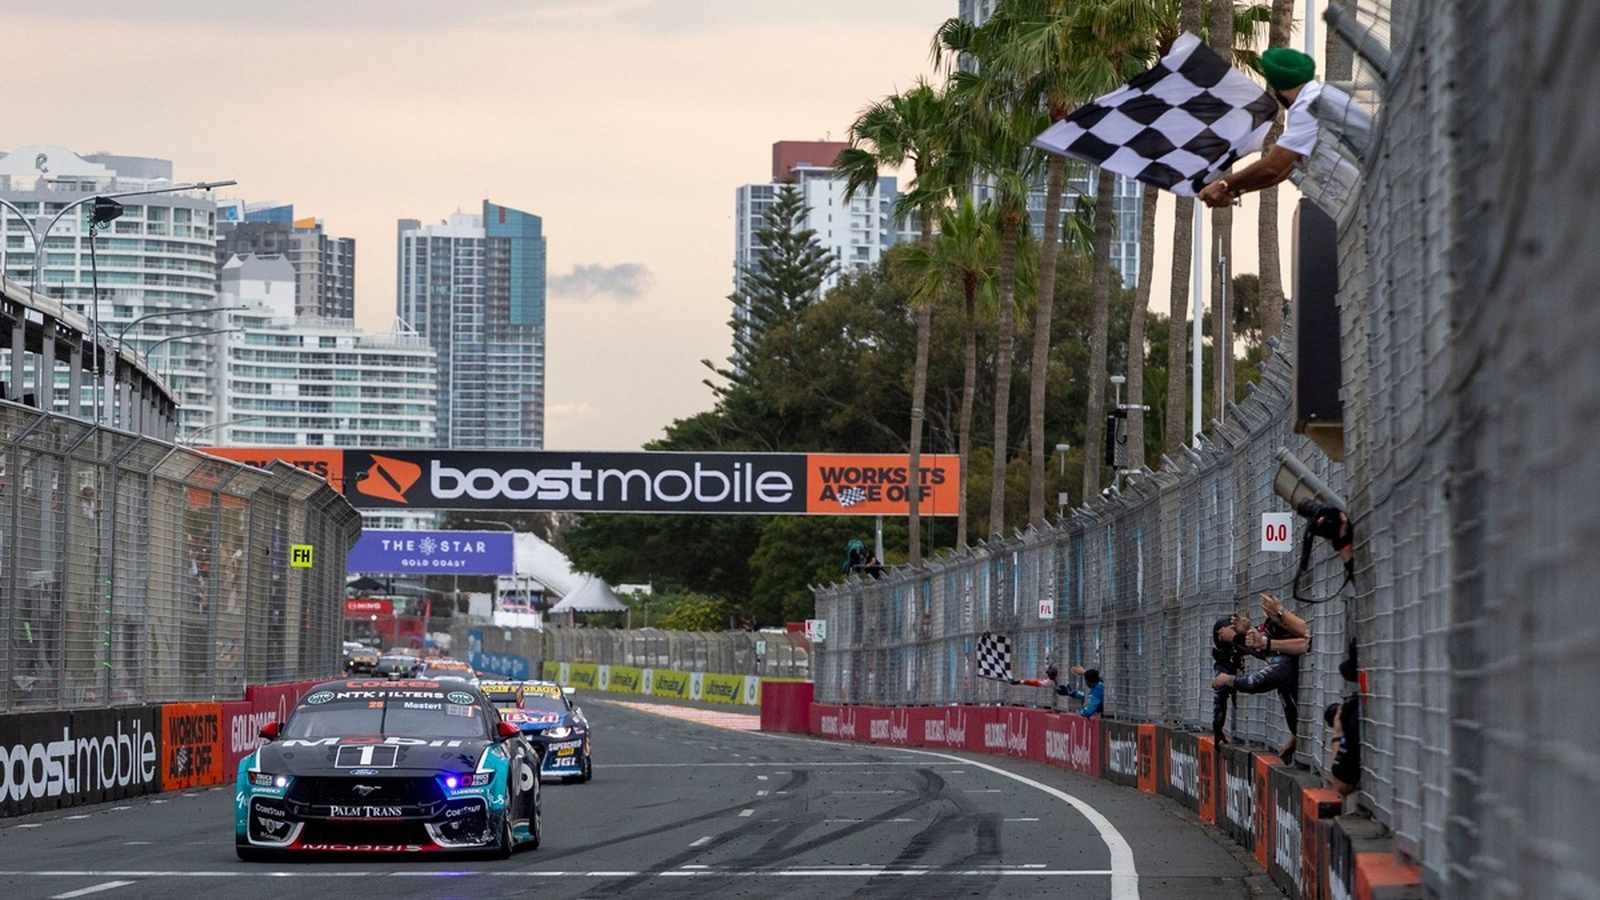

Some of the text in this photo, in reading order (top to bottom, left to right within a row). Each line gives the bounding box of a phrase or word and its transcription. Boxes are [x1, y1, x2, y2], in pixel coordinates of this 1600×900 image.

[819, 466, 946, 484] WORKS TS
[1266, 524, 1287, 542] 0.0
[381, 539, 486, 553] THE STAR
[293, 549, 310, 562] FH
[401, 559, 428, 567] GOLD
[337, 691, 376, 699] NTK
[404, 702, 442, 711] Mostert
[169, 715, 203, 746] WORKS
[357, 746, 375, 765] 1
[330, 805, 402, 817] PALM TRANS
